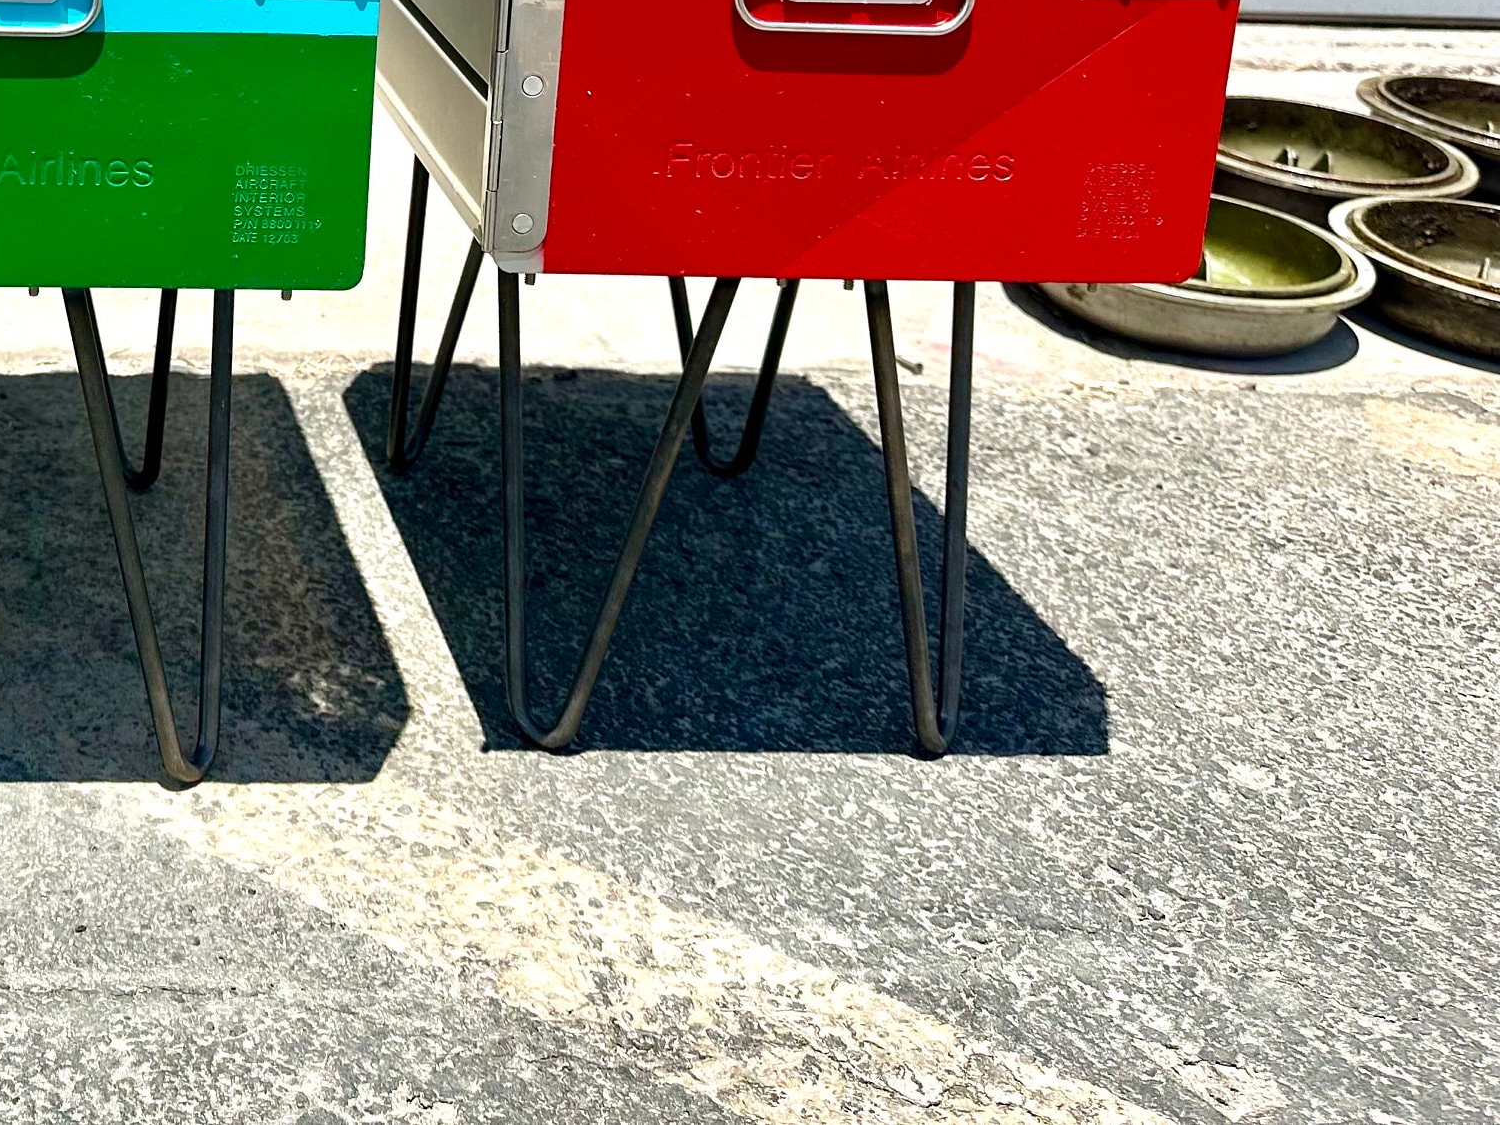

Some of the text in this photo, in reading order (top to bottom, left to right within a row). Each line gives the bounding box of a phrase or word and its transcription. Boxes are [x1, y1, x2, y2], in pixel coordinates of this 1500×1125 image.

[667, 141, 1015, 182] Frontier Airlines
[235, 165, 308, 177] DRIESSEN
[1085, 162, 1155, 174] DRESSEN
[235, 178, 307, 190] AIRCRAFT
[234, 192, 306, 204] INTERIOR
[1082, 189, 1152, 201] NTEROR
[233, 205, 305, 217] SYSTEMS
[233, 219, 258, 230] P/N
[232, 231, 299, 245] DATE 12/03
